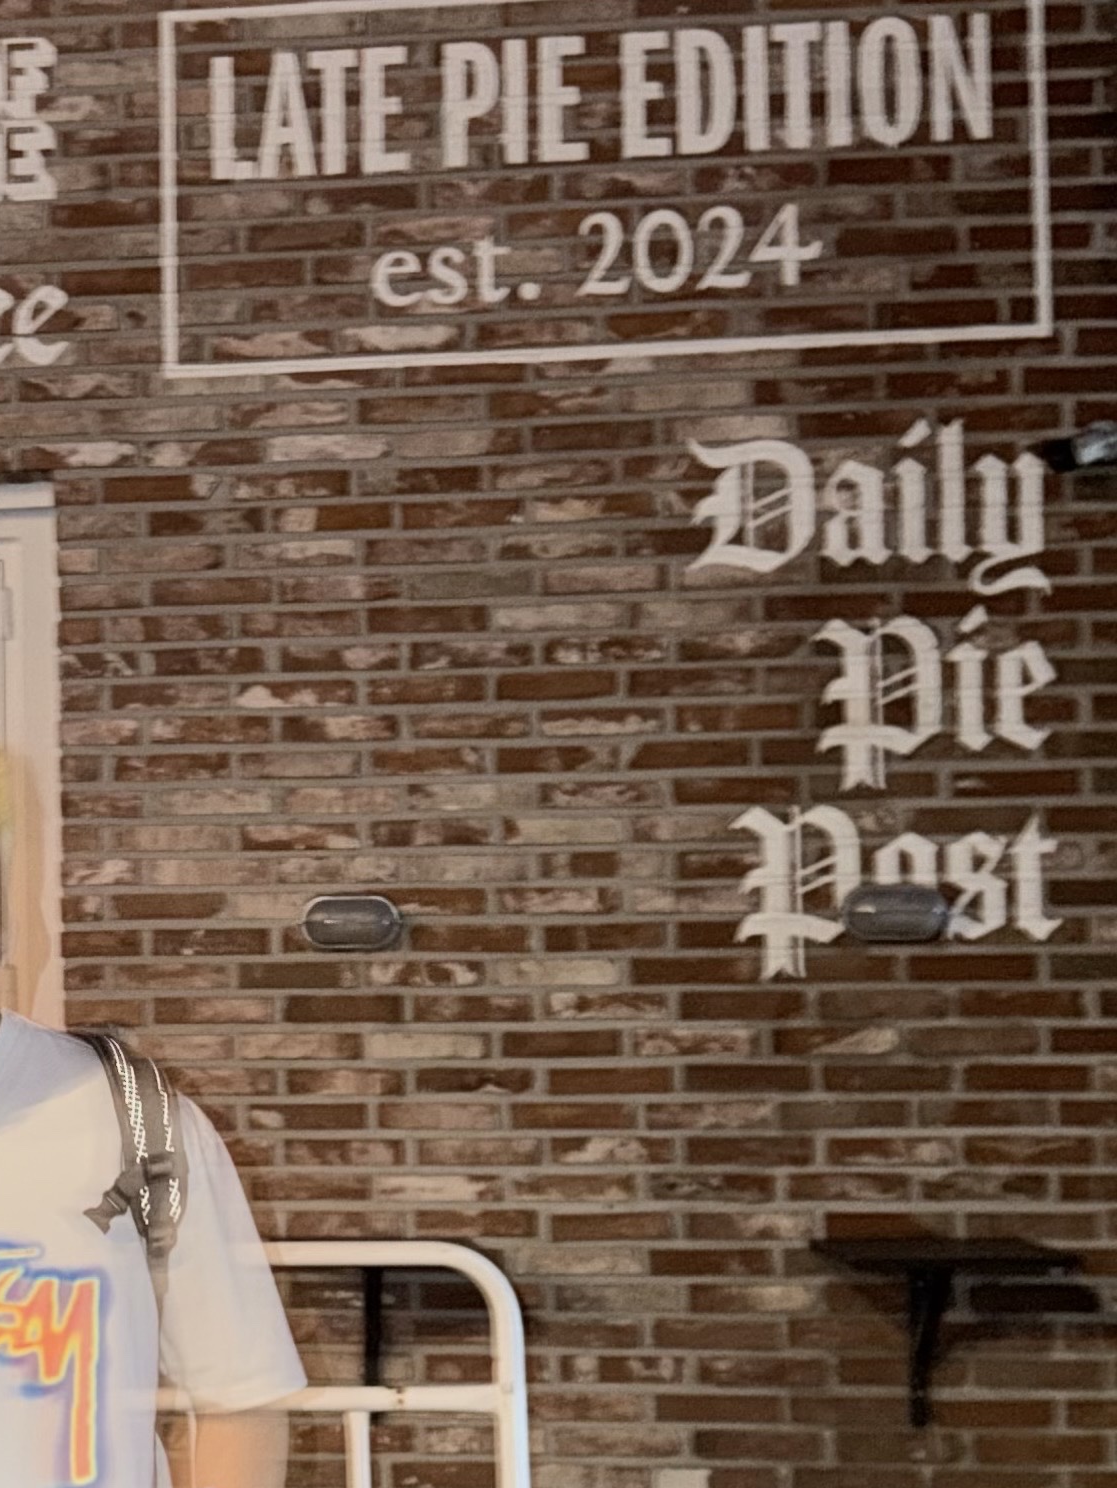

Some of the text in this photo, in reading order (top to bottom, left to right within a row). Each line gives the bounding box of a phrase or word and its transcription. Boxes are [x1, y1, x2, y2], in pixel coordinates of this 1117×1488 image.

[206, 12, 994, 181] LATE PIE EDITION
[370, 203, 823, 308] est. 2024
[686, 417, 1053, 596] Daily
[811, 604, 1057, 792] Pie
